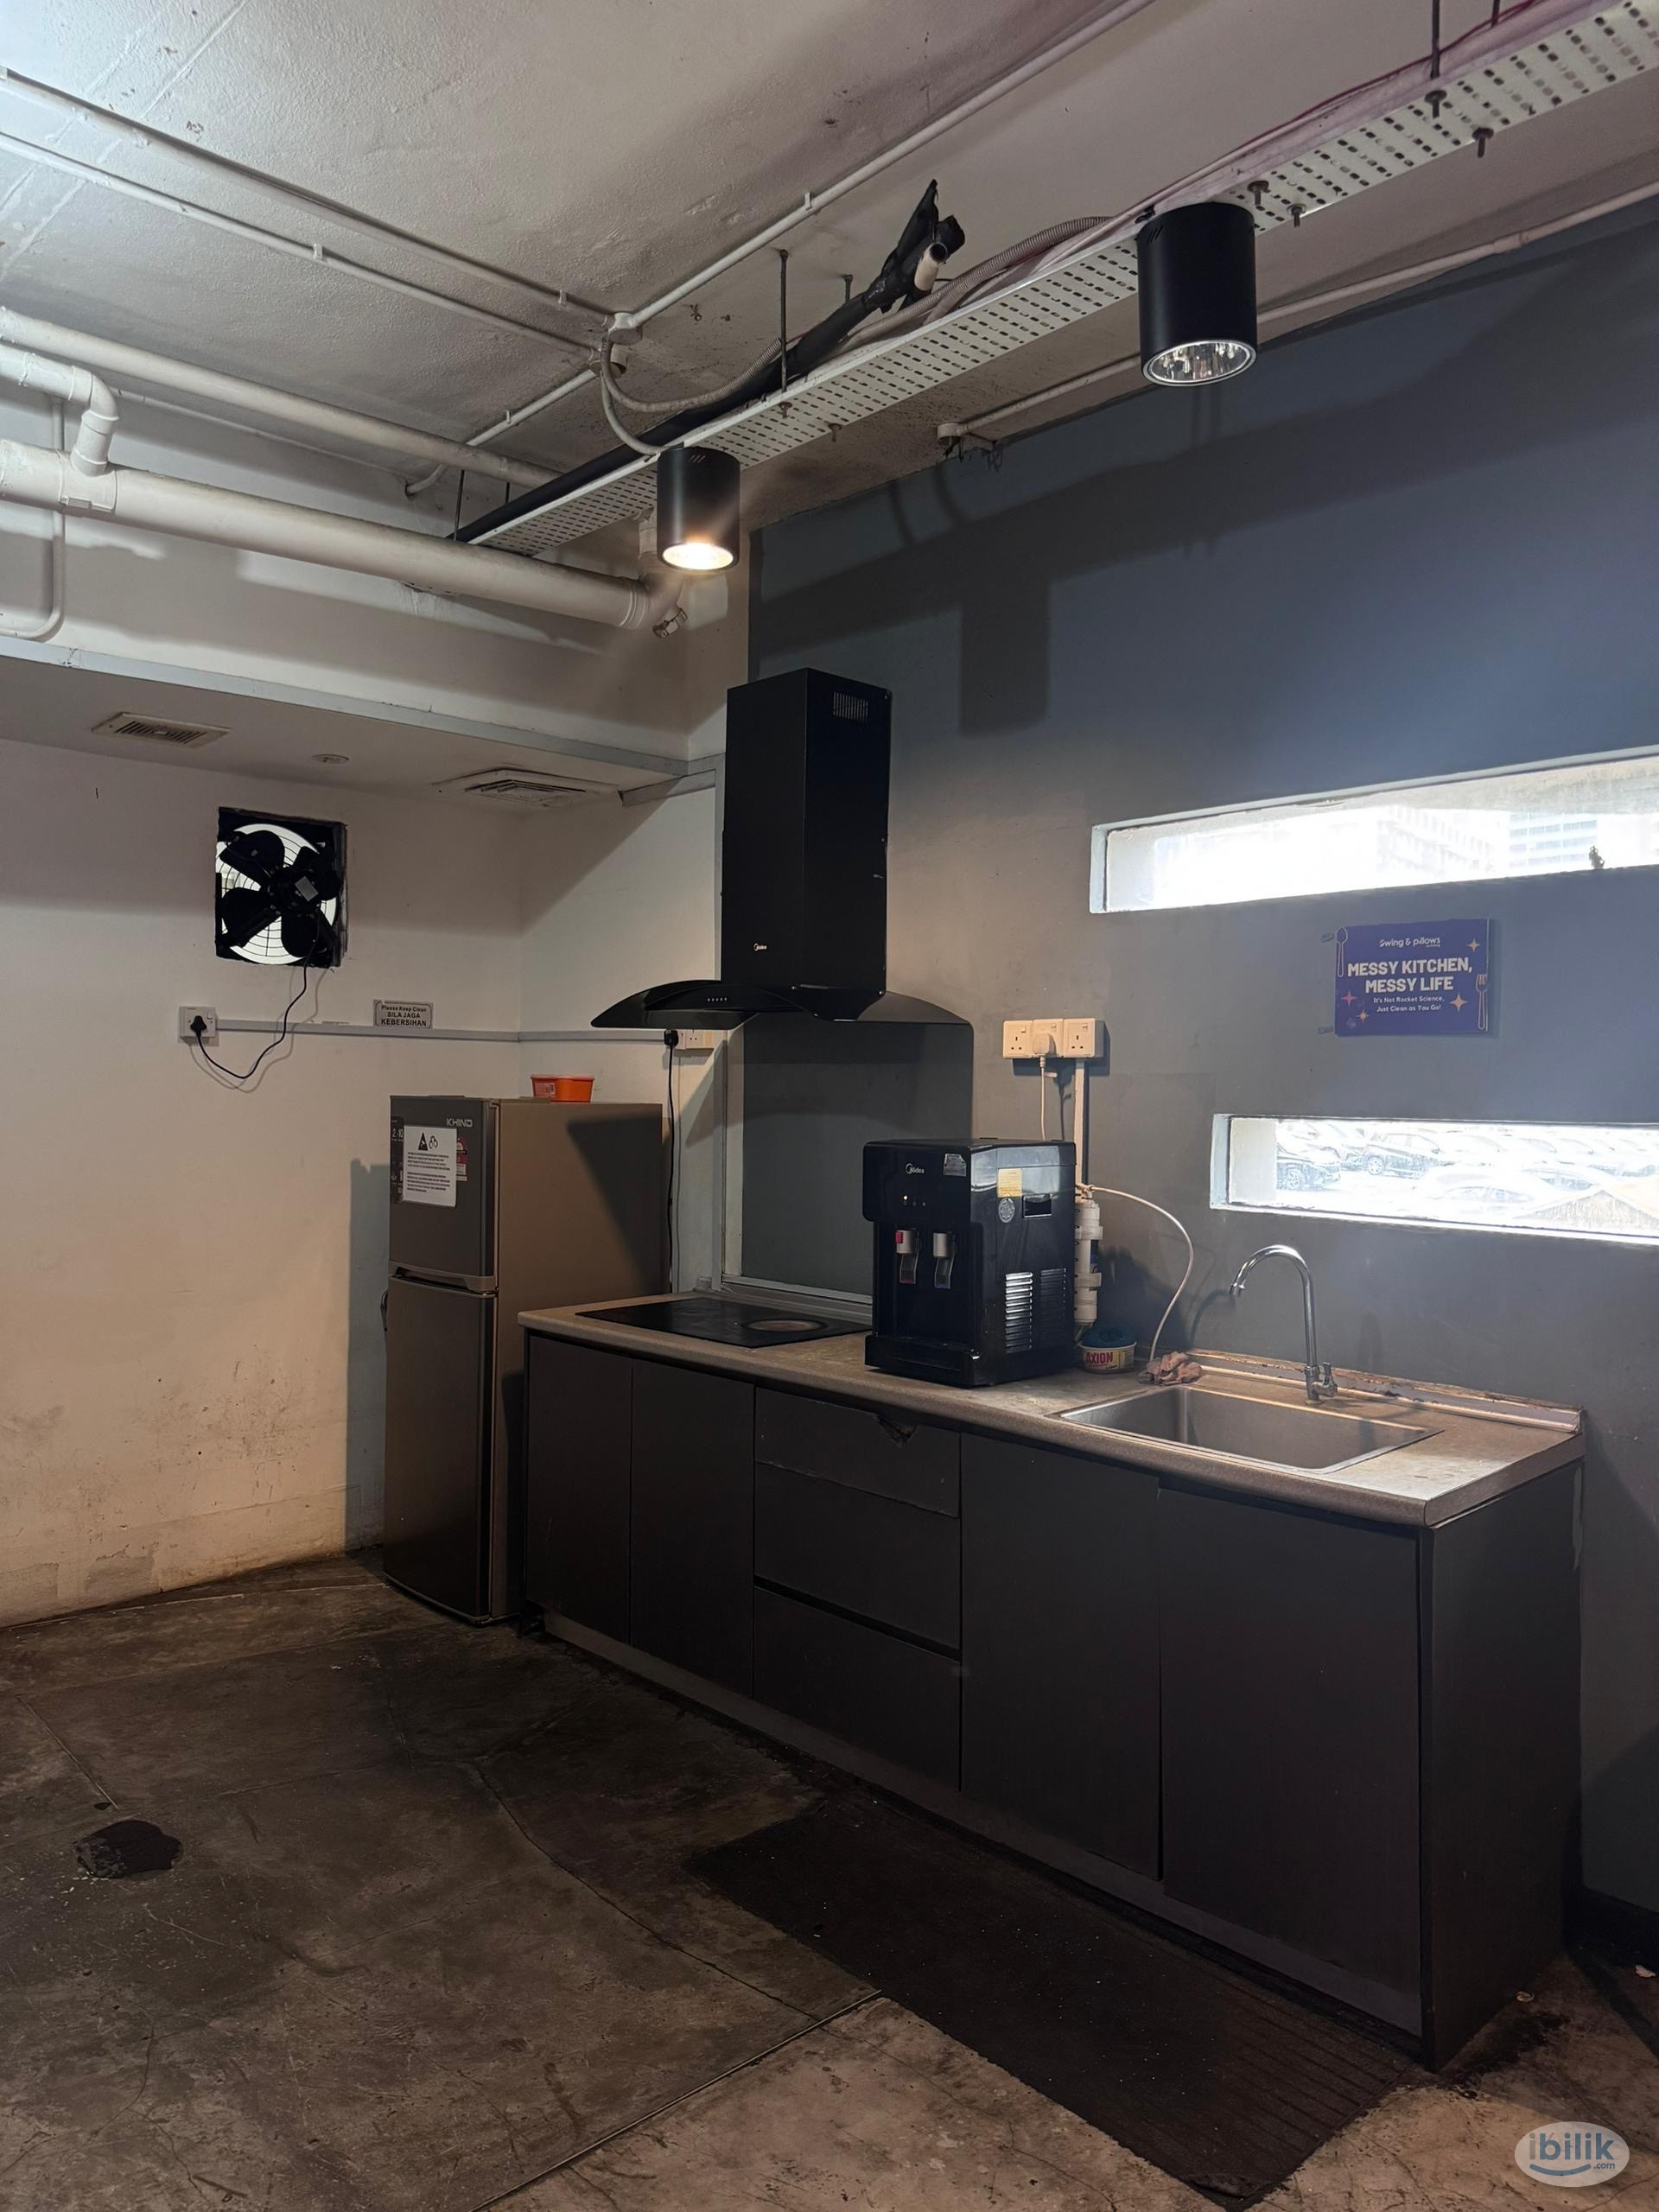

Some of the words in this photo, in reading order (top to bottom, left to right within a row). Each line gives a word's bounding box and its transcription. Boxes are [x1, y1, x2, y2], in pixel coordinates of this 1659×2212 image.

[1405, 938, 1411, 946] &
[1413, 937, 1440, 947] pillows
[1347, 961, 1399, 976] MESSY
[1402, 957, 1472, 975] KITCHEN,
[1365, 978, 1417, 994] MESSY
[1420, 976, 1453, 991] LIFE
[381, 1018, 427, 1027] KEBERSIHAN
[446, 1118, 473, 1128] KHIND
[906, 1163, 925, 1174] Midea
[1085, 1351, 1113, 1364] AXION
